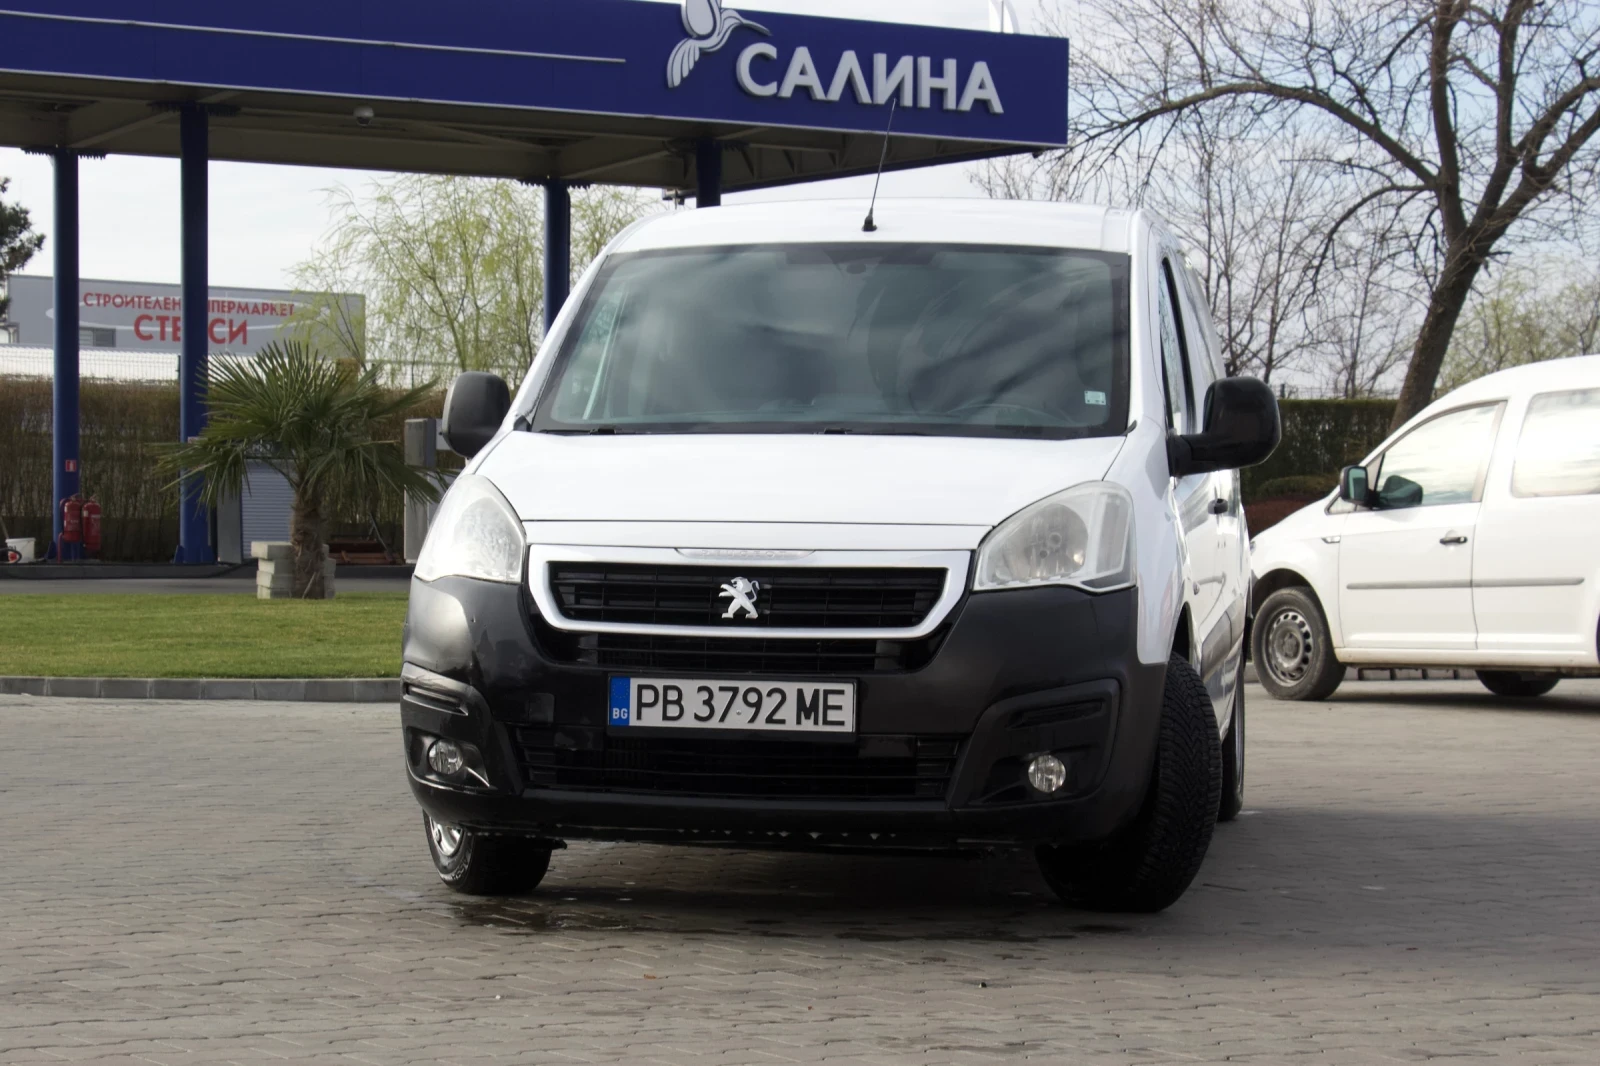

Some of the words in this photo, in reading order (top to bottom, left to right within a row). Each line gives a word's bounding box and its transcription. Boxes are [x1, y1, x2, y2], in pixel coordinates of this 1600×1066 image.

[735, 42, 1004, 114] САЛИНА
[83, 292, 182, 311] СТРОИТЕЛЕН
[206, 299, 295, 317] ПЕРМАРКЕТ
[134, 314, 248, 345] СТЕСИ
[612, 707, 628, 720] BG
[693, 685, 787, 725] 3792
